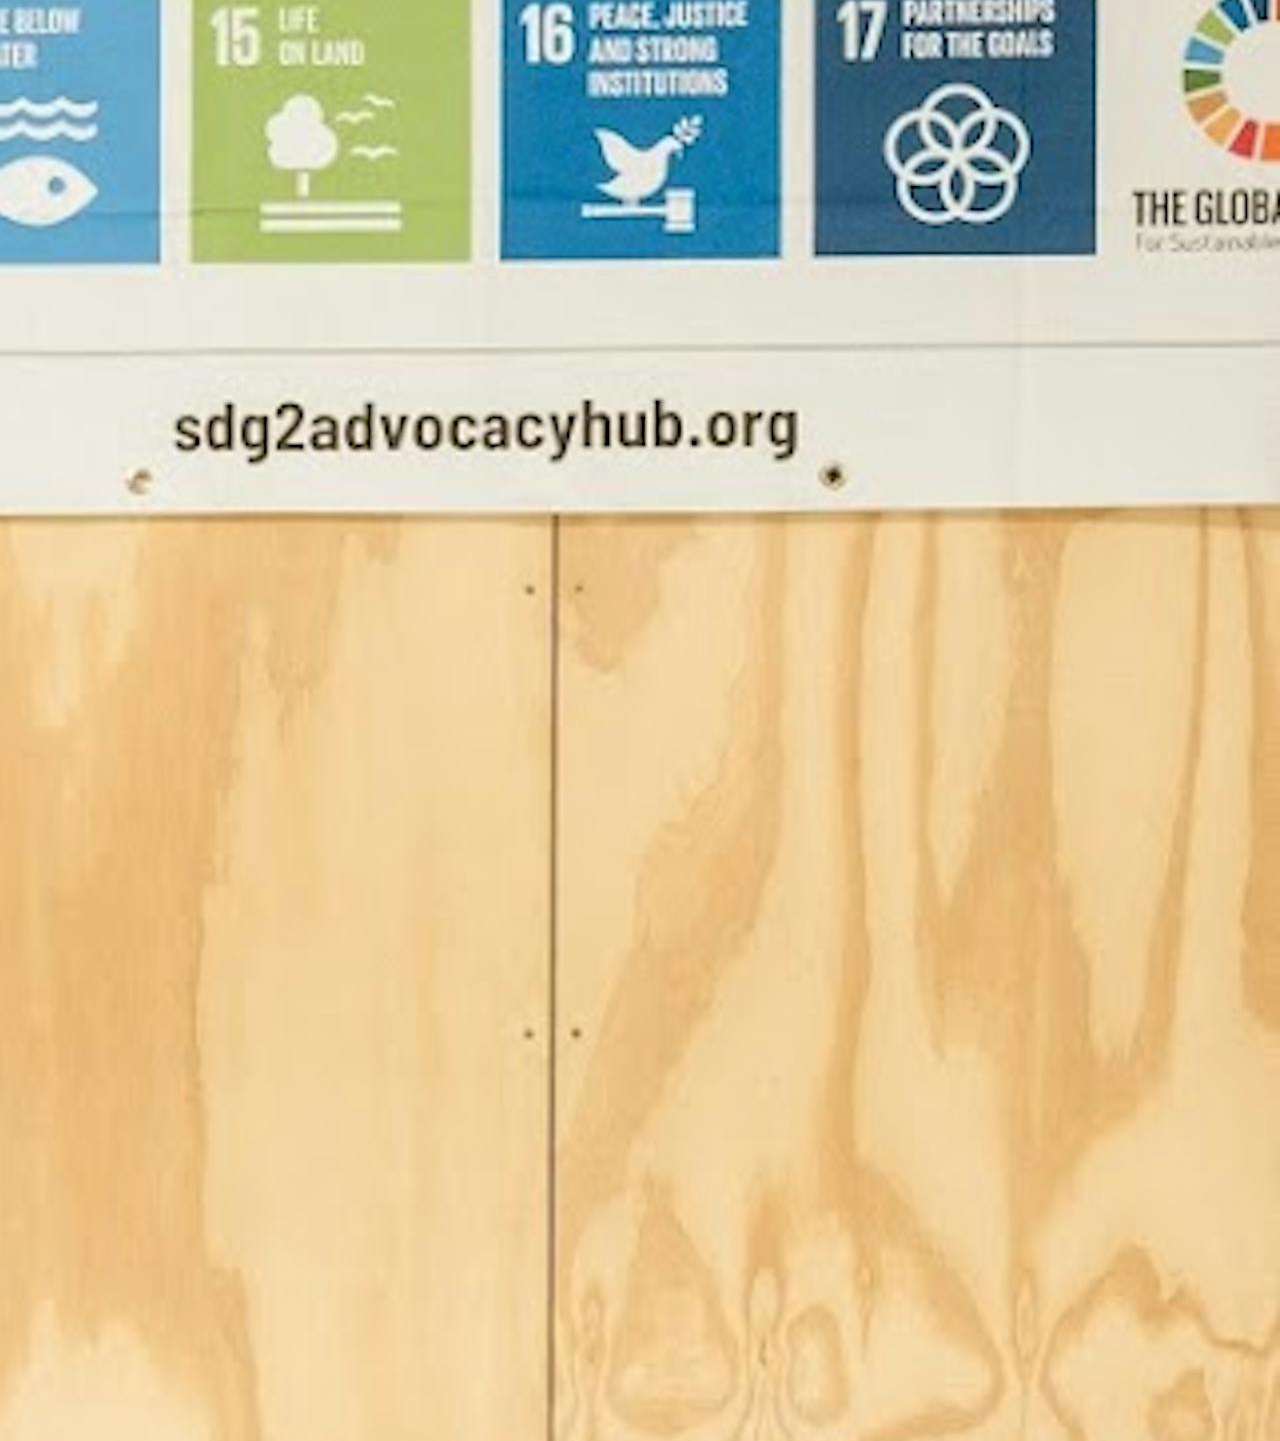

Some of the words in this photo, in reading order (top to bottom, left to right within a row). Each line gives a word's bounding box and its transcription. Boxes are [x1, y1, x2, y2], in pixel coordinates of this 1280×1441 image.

[12, 7, 81, 34] BELOW
[278, 5, 321, 34] LIFE
[519, 1, 577, 65] 16
[209, 5, 261, 67] 15
[278, 39, 307, 66] ON
[309, 37, 366, 66] LAND
[587, 34, 634, 65] AND
[635, 34, 720, 64] STRONG
[900, 29, 944, 60] FOR
[944, 29, 986, 59] THE
[987, 27, 1056, 58] GOALS
[586, 67, 730, 98] INSTITUTIONS
[1132, 188, 1188, 227] THE
[175, 398, 798, 465] sdg2advocacyhub.org
